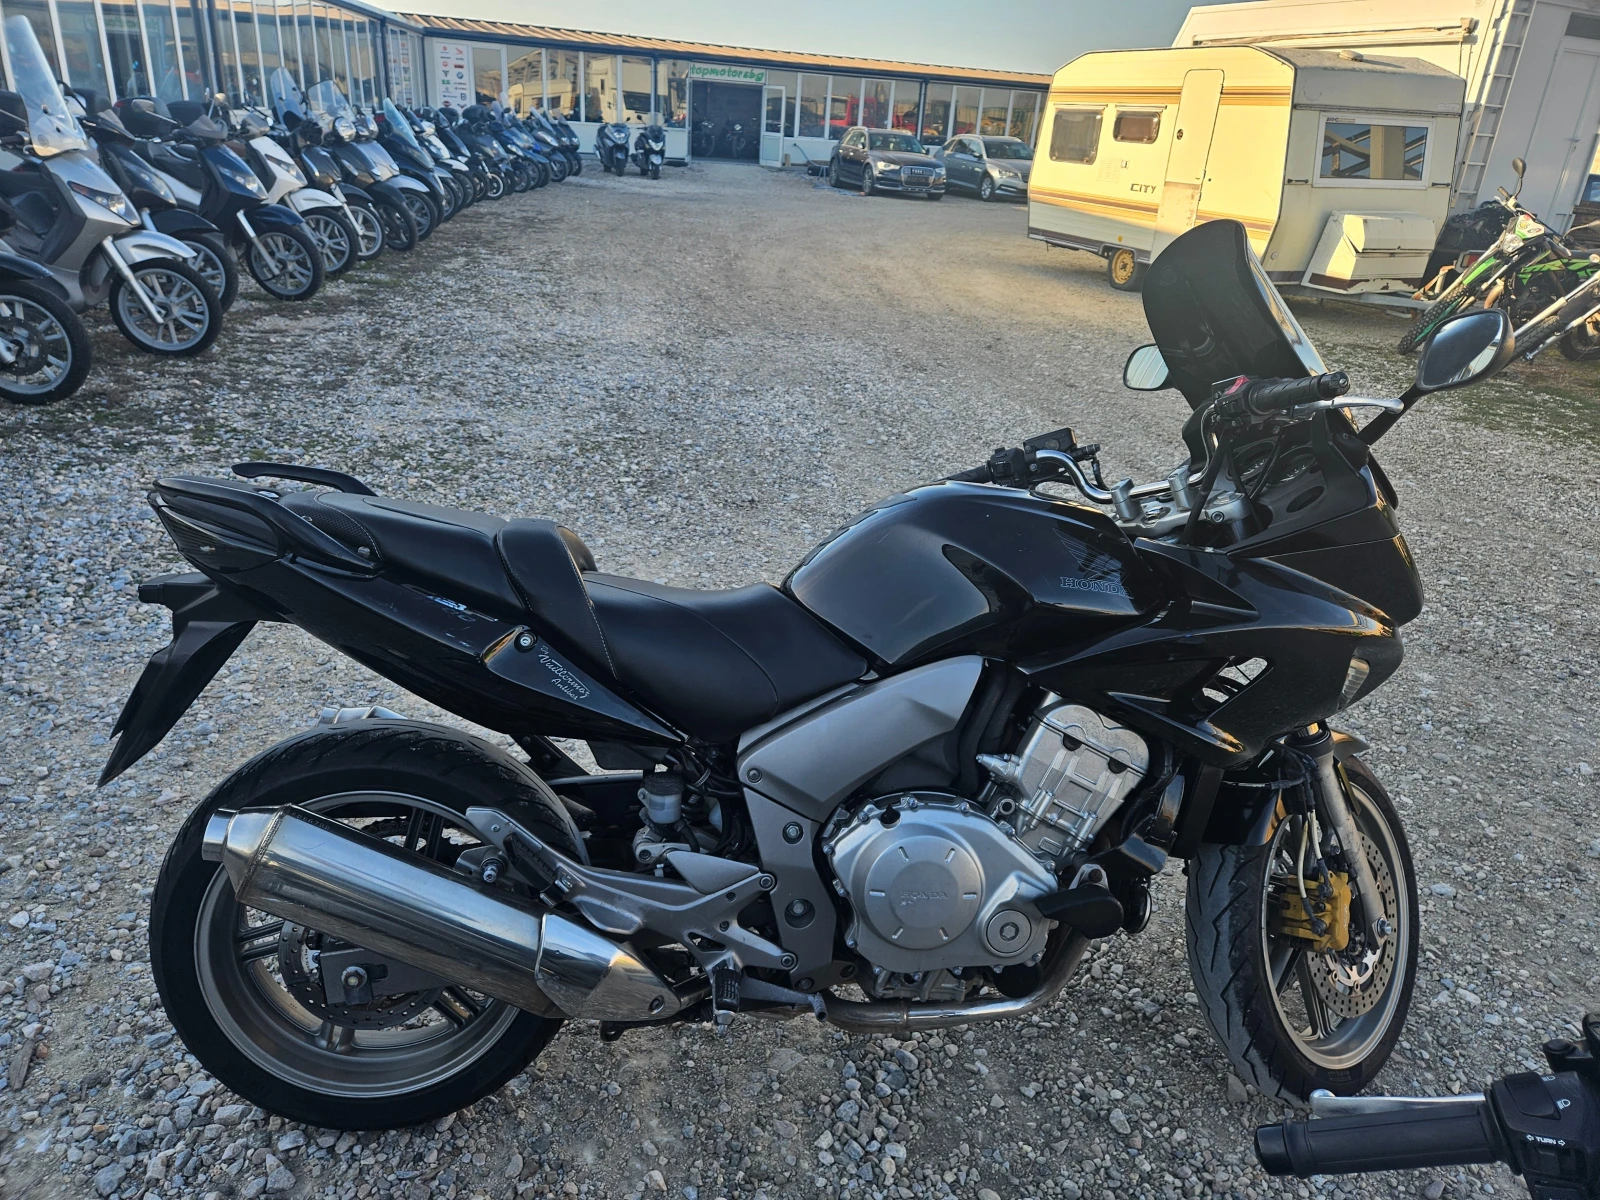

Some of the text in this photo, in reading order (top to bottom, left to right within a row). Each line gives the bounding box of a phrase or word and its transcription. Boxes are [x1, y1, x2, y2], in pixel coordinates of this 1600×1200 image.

[1130, 183, 1157, 194] CITY
[1060, 576, 1134, 599] HONDA
[1535, 1135, 1557, 1145] TURN
